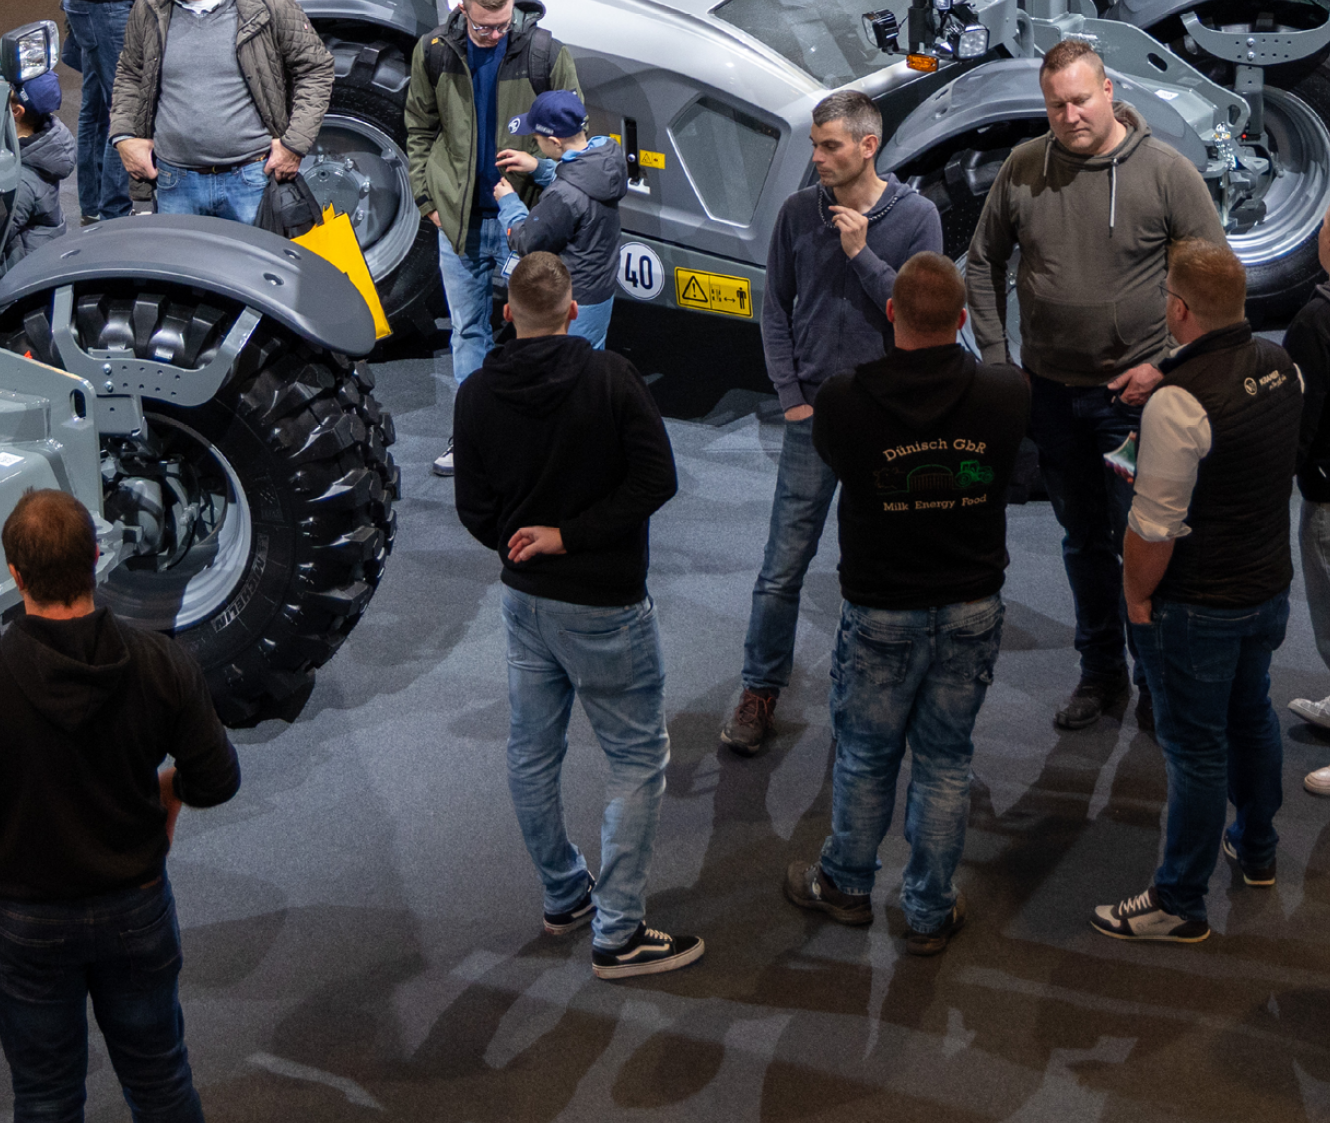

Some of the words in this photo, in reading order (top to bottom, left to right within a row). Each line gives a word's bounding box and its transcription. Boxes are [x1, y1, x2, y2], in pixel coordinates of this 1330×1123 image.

[624, 251, 653, 290] 40
[882, 438, 948, 462] Dünisch
[953, 438, 987, 454] GbR
[883, 502, 909, 512] Milk
[915, 500, 956, 510] Energy
[961, 493, 987, 507] Food
